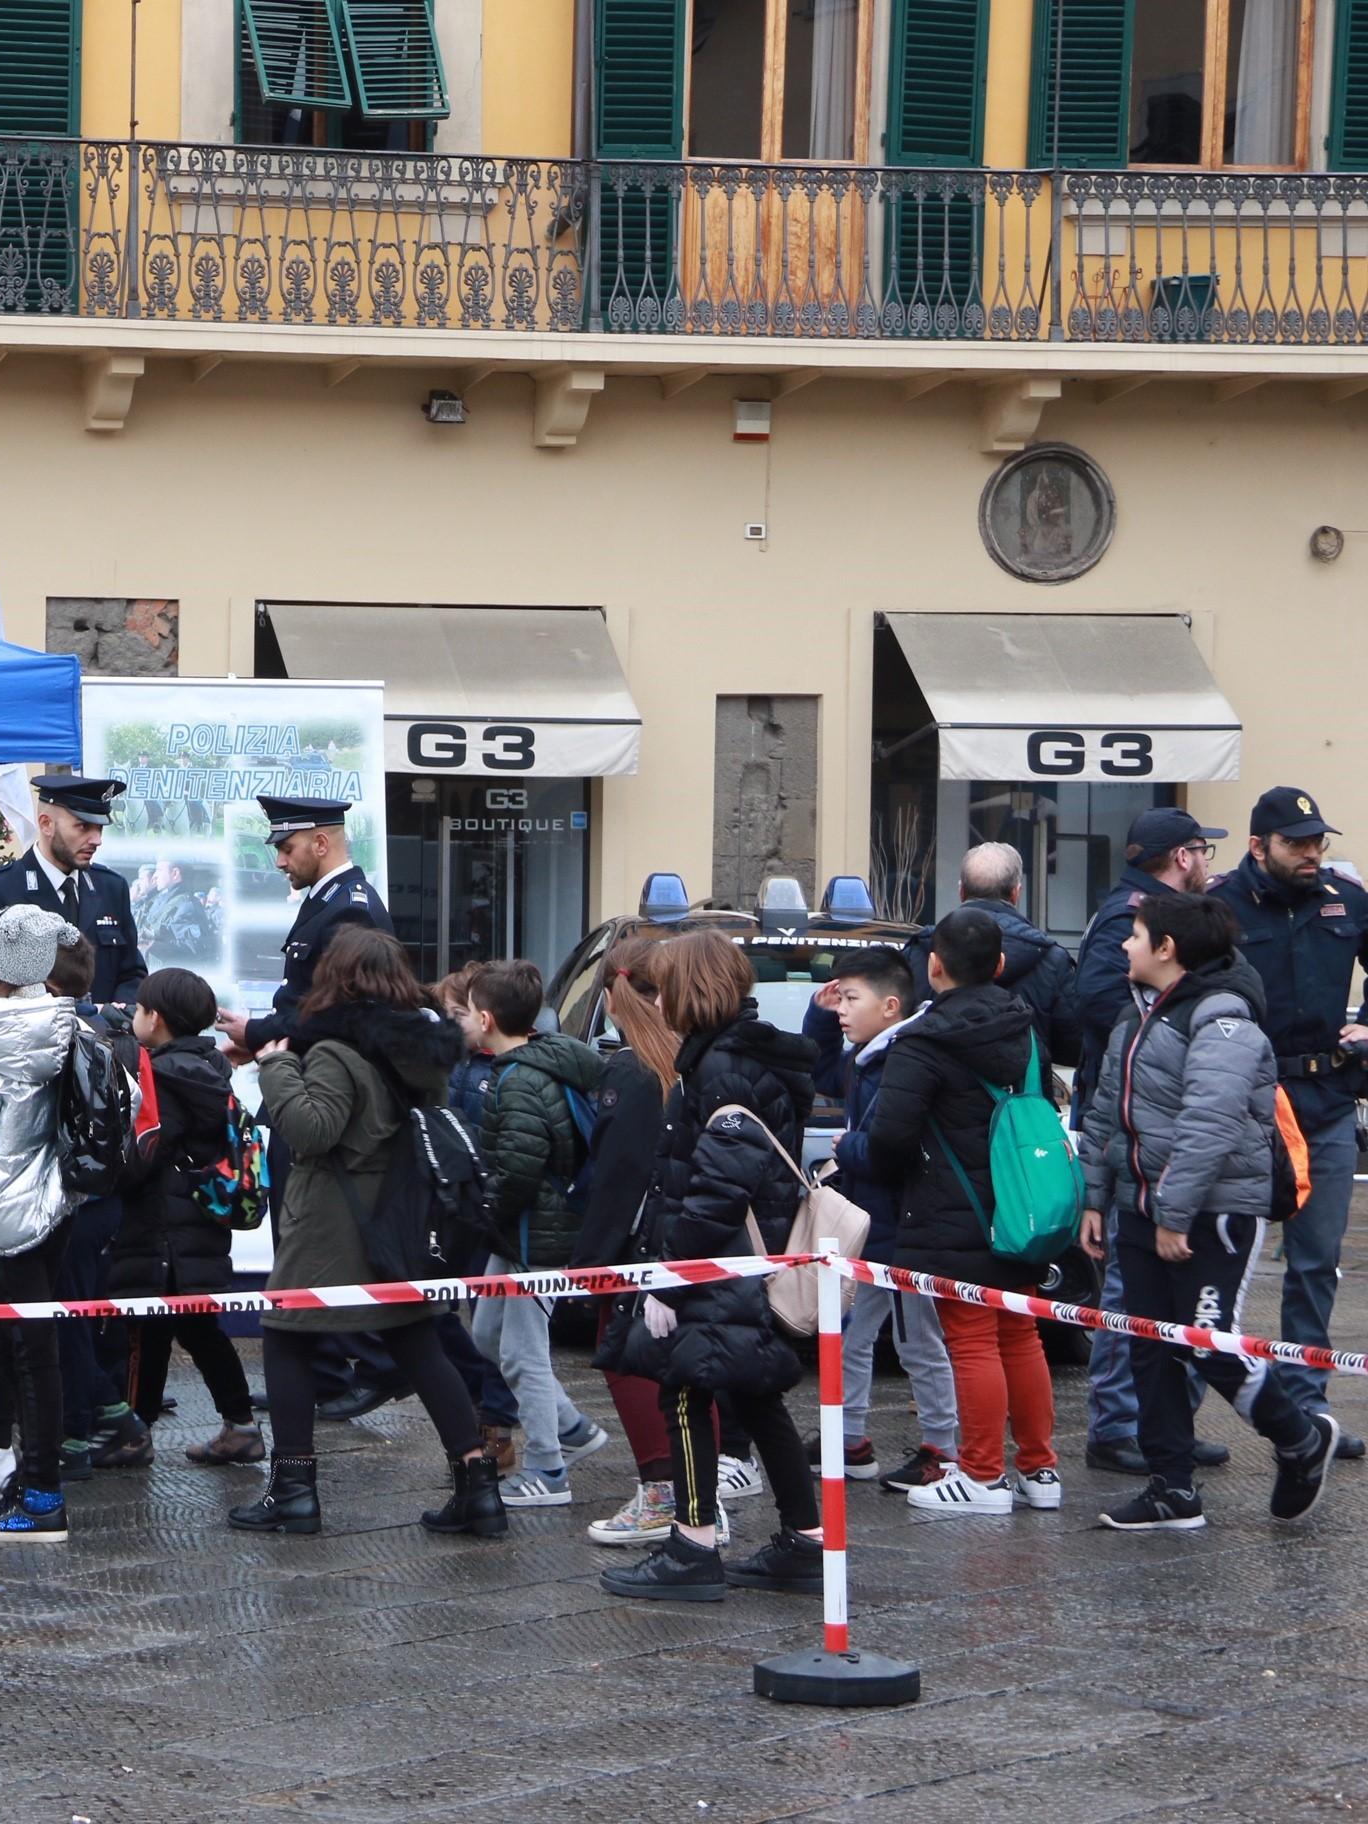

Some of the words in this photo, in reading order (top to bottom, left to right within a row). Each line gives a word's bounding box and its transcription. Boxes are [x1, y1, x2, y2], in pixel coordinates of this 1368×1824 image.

[167, 723, 301, 755] POLIZIA
[407, 723, 535, 770] G3
[1028, 731, 1153, 776] G3
[486, 789, 528, 809] G3
[450, 819, 564, 833] BOUTIQUE
[423, 1282, 507, 1301] POLIZIA
[516, 1270, 653, 1296] MUNICIPALE
